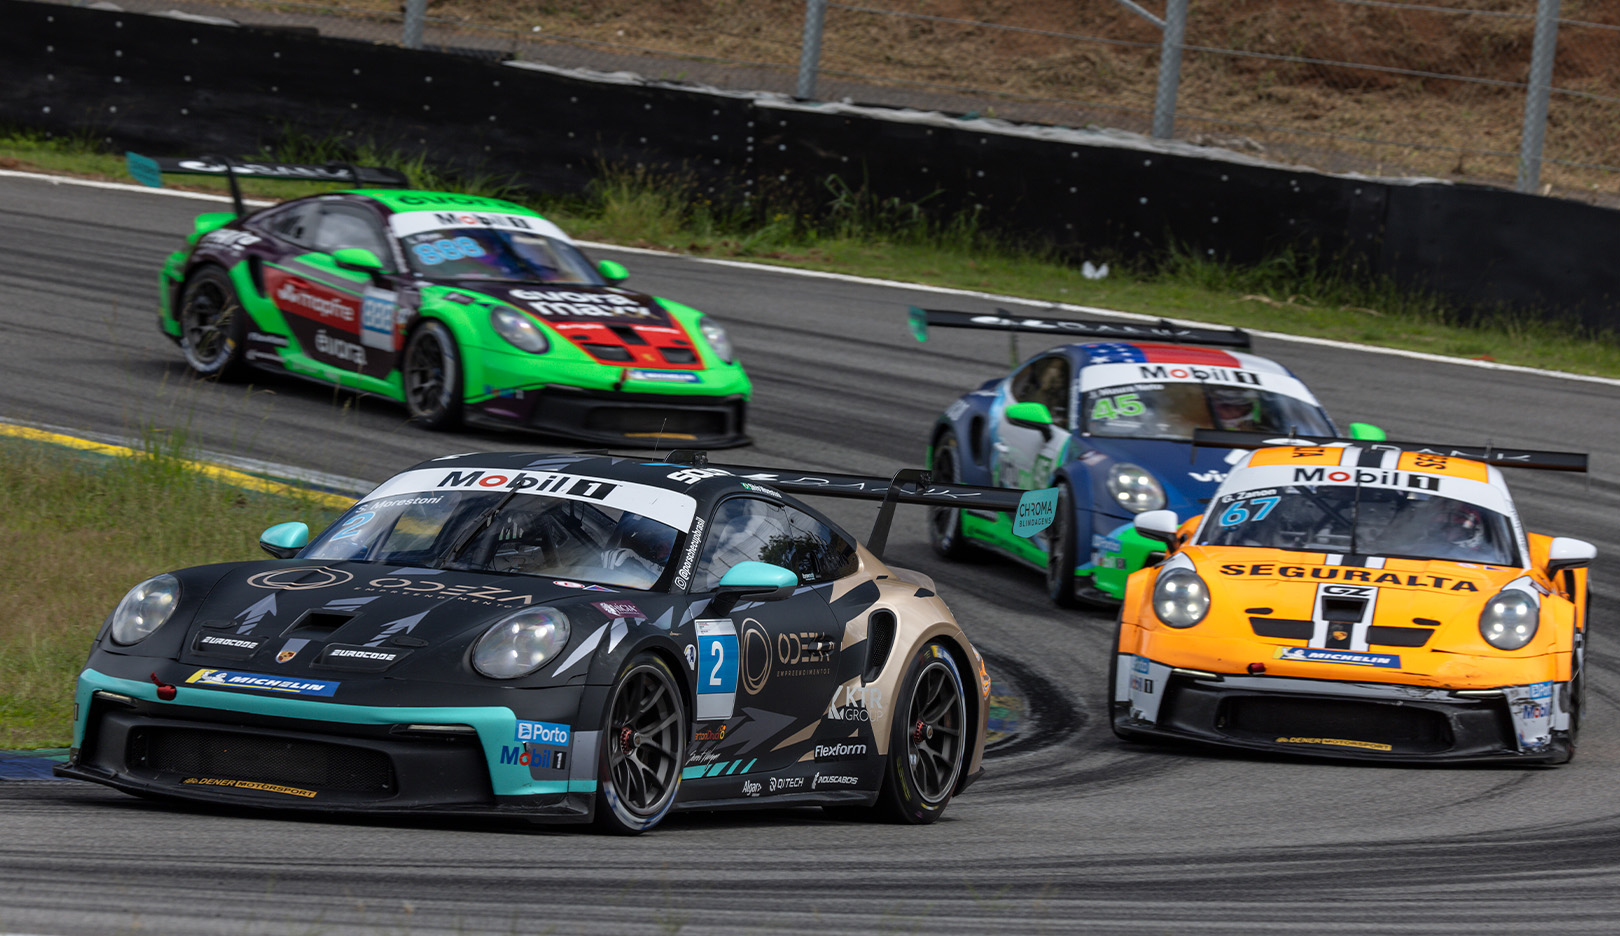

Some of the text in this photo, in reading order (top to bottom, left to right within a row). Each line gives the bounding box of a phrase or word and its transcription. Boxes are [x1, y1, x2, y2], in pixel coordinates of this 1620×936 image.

[413, 237, 486, 265] 888
[1140, 366, 1229, 381] Mobil
[1091, 393, 1147, 419] 45
[438, 470, 570, 493] Mobil
[1293, 468, 1398, 485] Mobil
[355, 496, 444, 514] S. Morestoni
[1222, 489, 1278, 503] G. Zanon
[1019, 501, 1052, 517] CHROMA
[1219, 496, 1281, 526] 67
[329, 511, 376, 542] 2
[1019, 517, 1052, 528] BLINDAGENS
[678, 516, 705, 581] @porschecupbrasil
[1219, 563, 1479, 592] SEGURALTA
[369, 578, 532, 604] ODEZA
[1322, 585, 1374, 597] GZ
[201, 636, 258, 649] EUROCODE
[330, 649, 397, 662] EUROCODE
[709, 640, 724, 685] 2
[1307, 652, 1391, 665] MICHELIN
[228, 676, 326, 691] MICHELIN
[845, 686, 883, 709] KTR
[845, 709, 884, 721] GROUP
[533, 724, 567, 743] Porto
[500, 745, 551, 768] Mobil
[814, 742, 867, 758] Flexform
[199, 778, 317, 798] DENER MOTORSPORT
